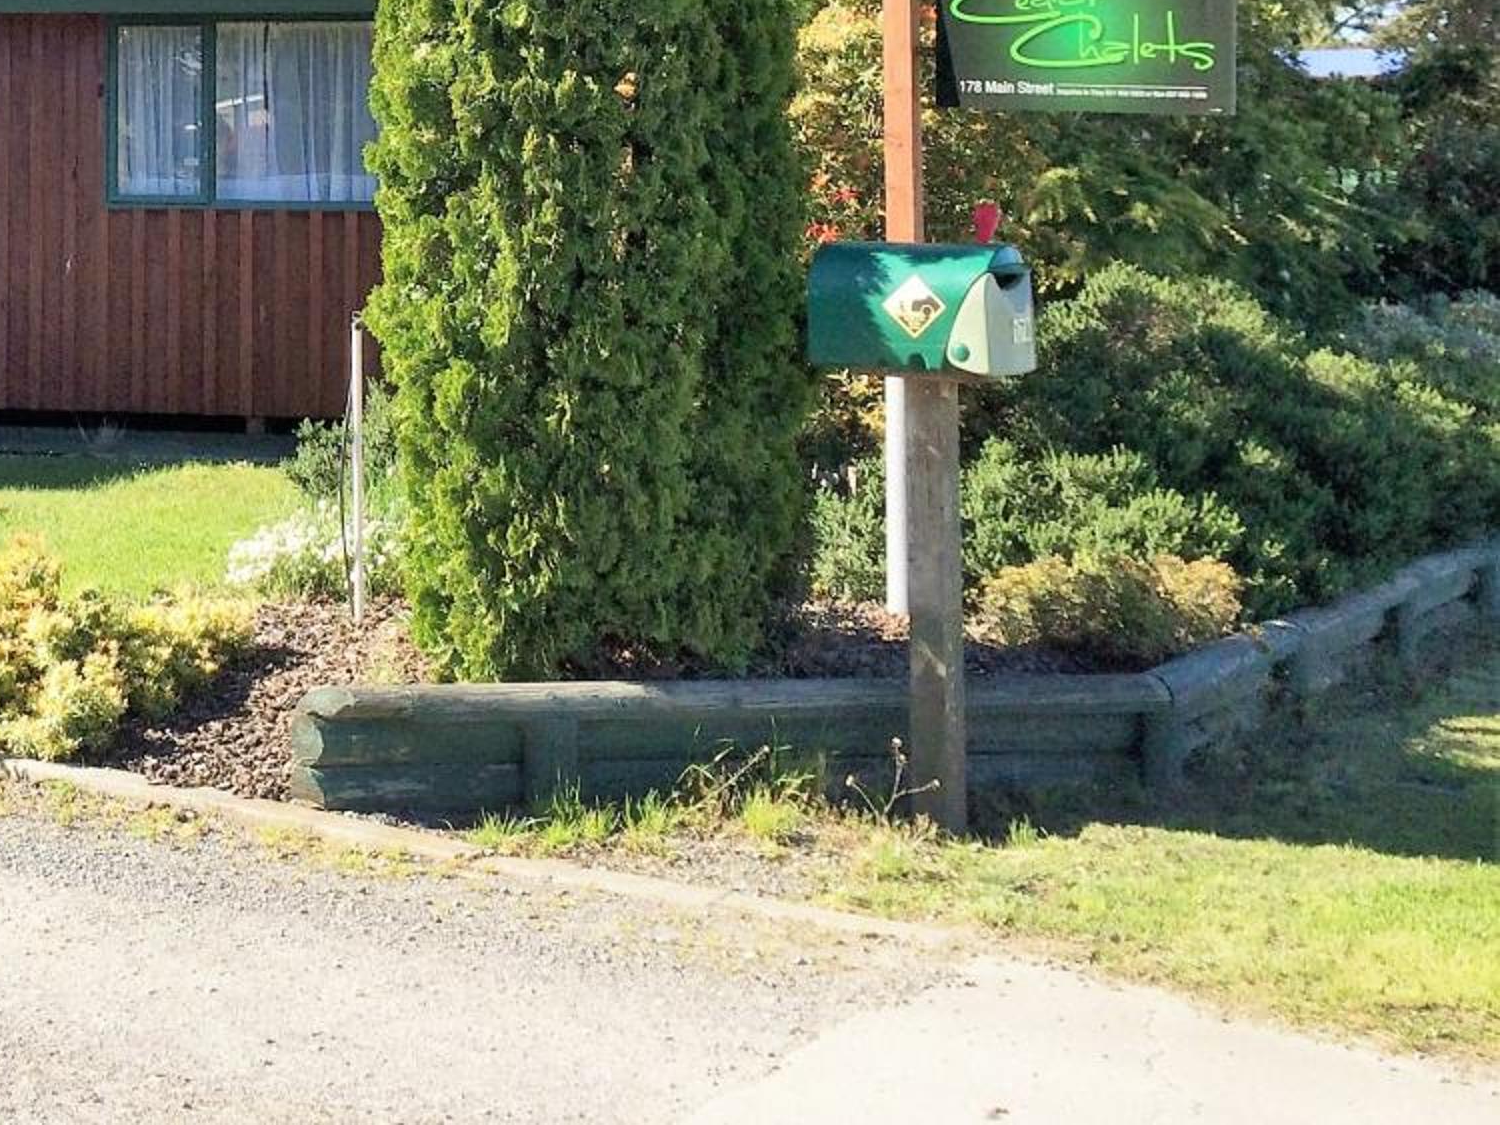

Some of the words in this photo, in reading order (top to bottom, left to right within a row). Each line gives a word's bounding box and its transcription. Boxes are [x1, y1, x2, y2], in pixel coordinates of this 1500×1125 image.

[1010, 10, 1215, 71] Chalets
[959, 80, 982, 94] 178
[984, 80, 1015, 94] Main
[1017, 80, 1055, 96] Street
